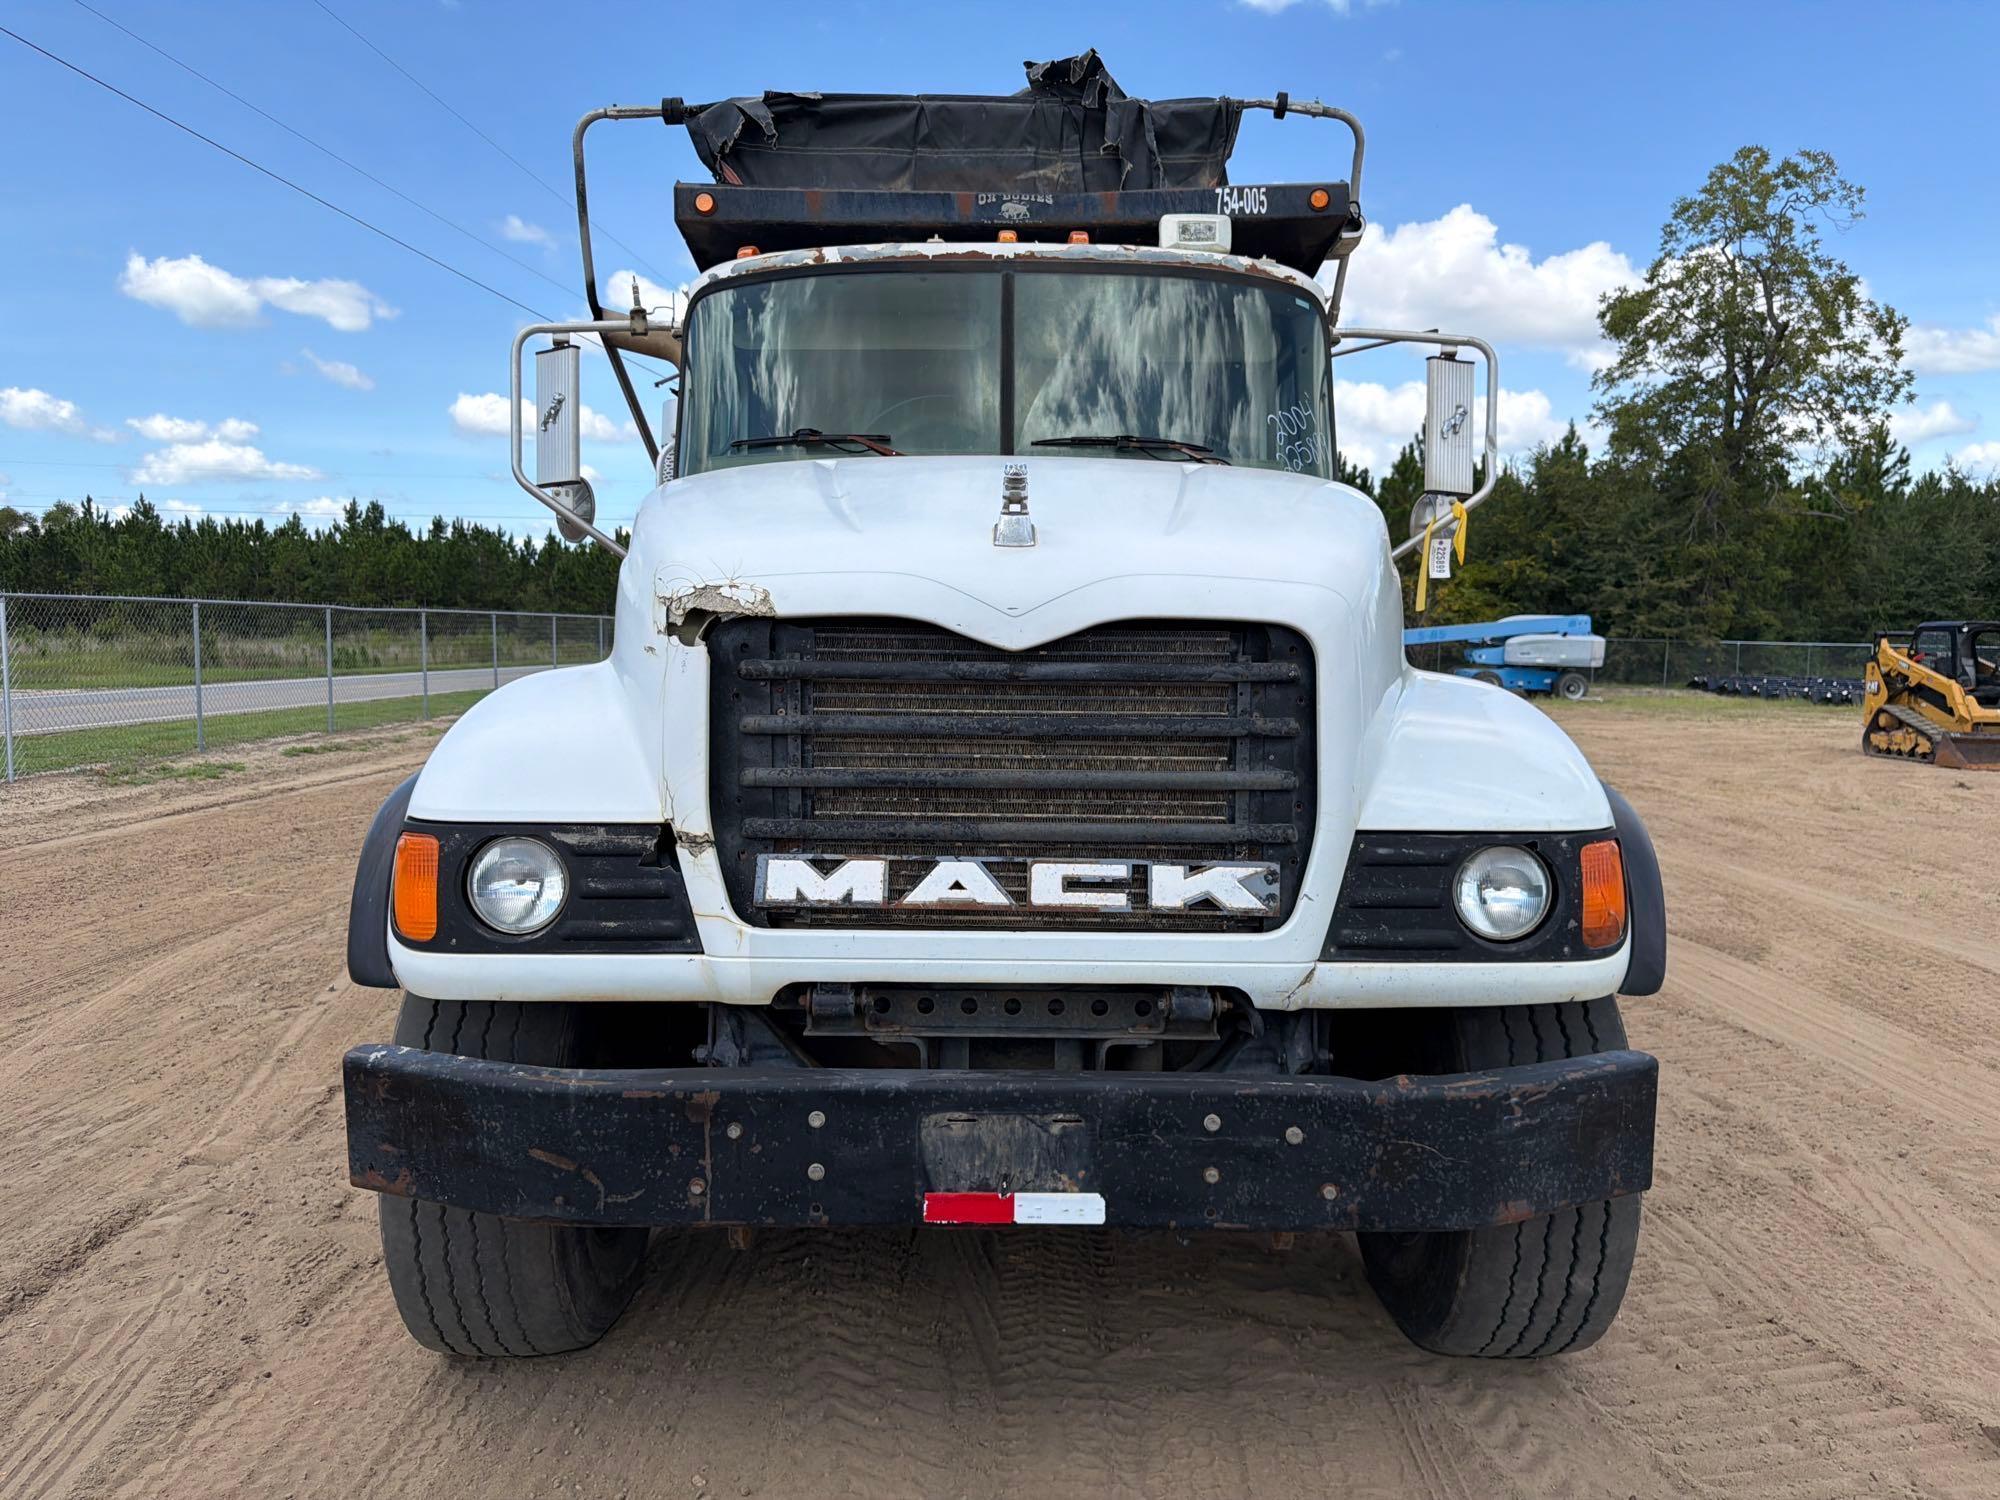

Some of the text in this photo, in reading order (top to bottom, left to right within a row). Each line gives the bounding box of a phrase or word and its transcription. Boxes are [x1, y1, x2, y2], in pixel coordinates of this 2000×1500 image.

[1215, 187, 1268, 215] 754-005
[1267, 392, 1317, 446] 2004
[760, 856, 1275, 914] MACK
